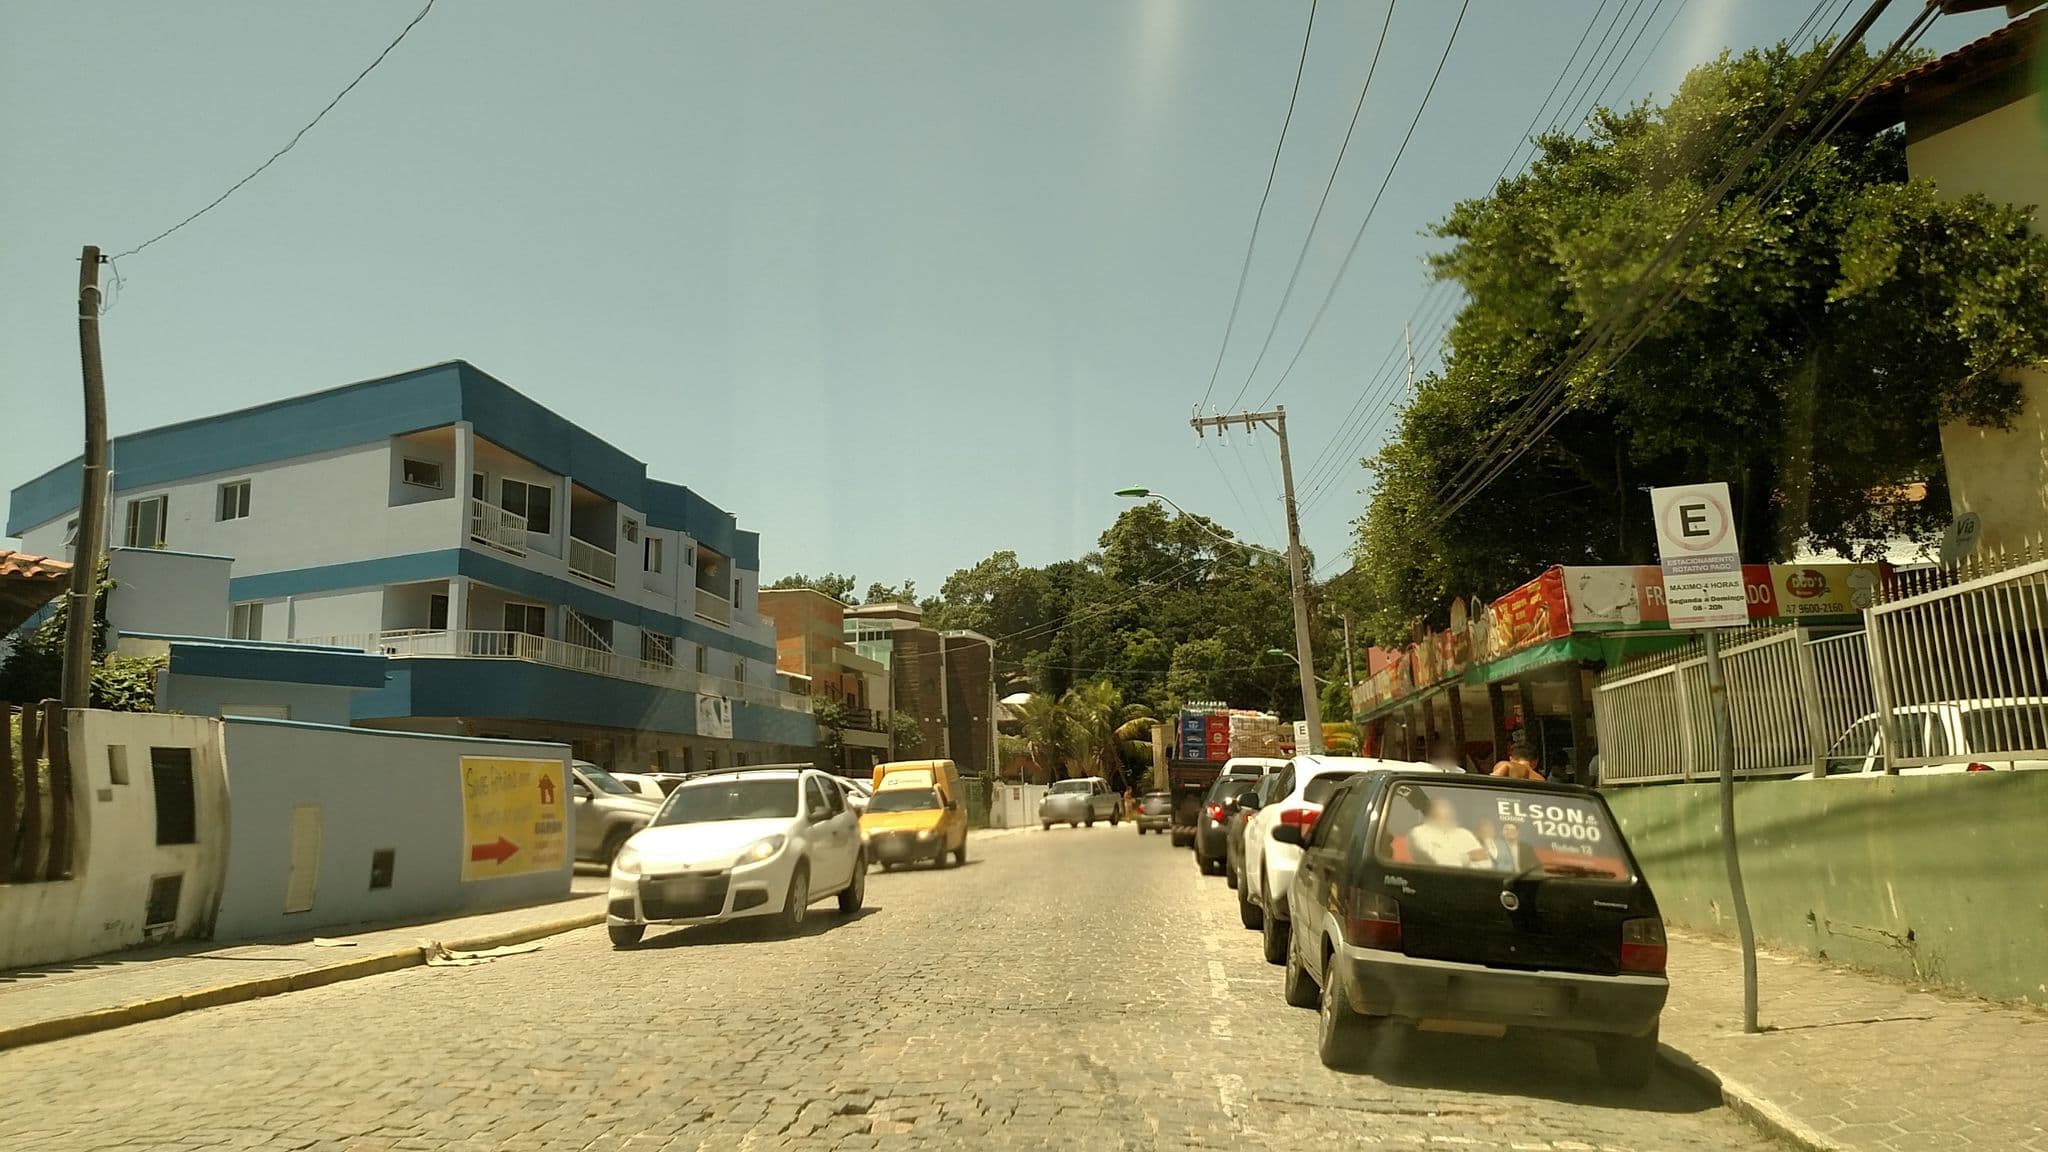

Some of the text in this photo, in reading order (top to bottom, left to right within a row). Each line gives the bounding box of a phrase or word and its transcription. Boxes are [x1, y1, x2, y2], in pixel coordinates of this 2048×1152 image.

[1679, 503, 1710, 537] E
[1666, 556, 1735, 567] ESTACIONAMENTO
[1672, 563, 1731, 574] ROTATIVO PAGO
[1669, 583, 1702, 591] MAXIMO
[1645, 585, 1666, 607] FR
[1668, 596, 1702, 605] Segunda
[1710, 595, 1744, 603] Domingo
[1497, 801, 1583, 824] ELSON
[1532, 820, 1601, 842] 12000
